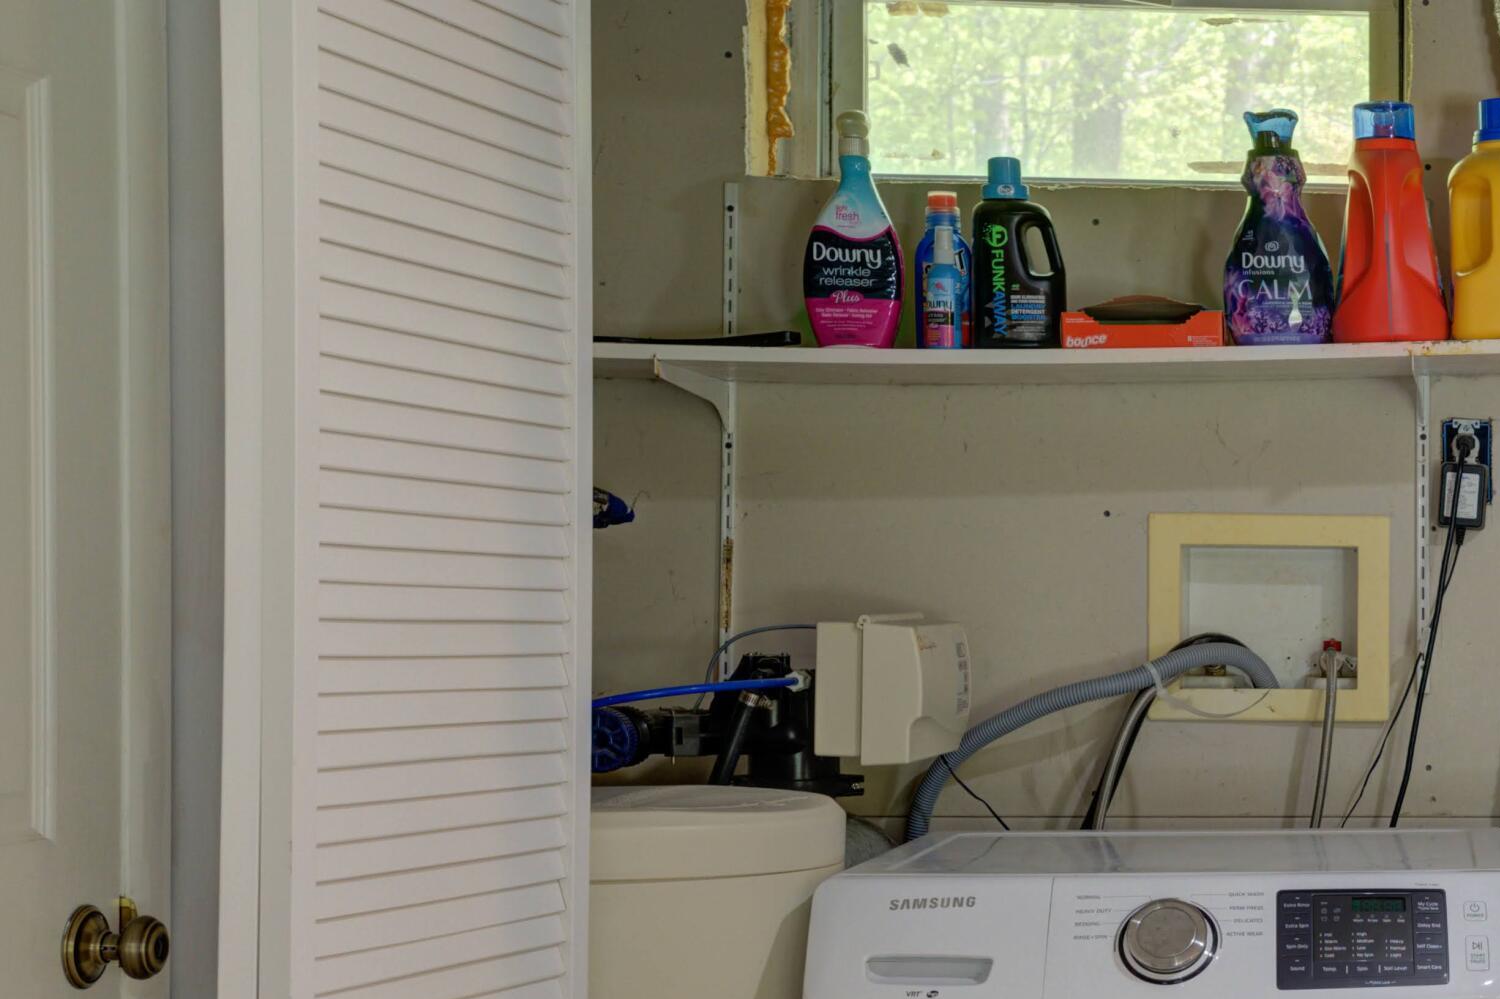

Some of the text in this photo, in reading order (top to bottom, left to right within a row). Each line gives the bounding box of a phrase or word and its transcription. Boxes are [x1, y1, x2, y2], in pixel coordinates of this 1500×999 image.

[835, 210, 859, 221] fresh
[813, 242, 881, 269] Downy
[1242, 252, 1305, 274] Downy
[823, 265, 871, 277] wrinkle
[819, 276, 875, 287] releaser
[832, 290, 860, 304] Plus
[991, 249, 1008, 338] FUNKAWAY
[1239, 279, 1313, 301] CALM
[1065, 334, 1107, 348] bounce
[889, 896, 976, 911] SAMSUNG
